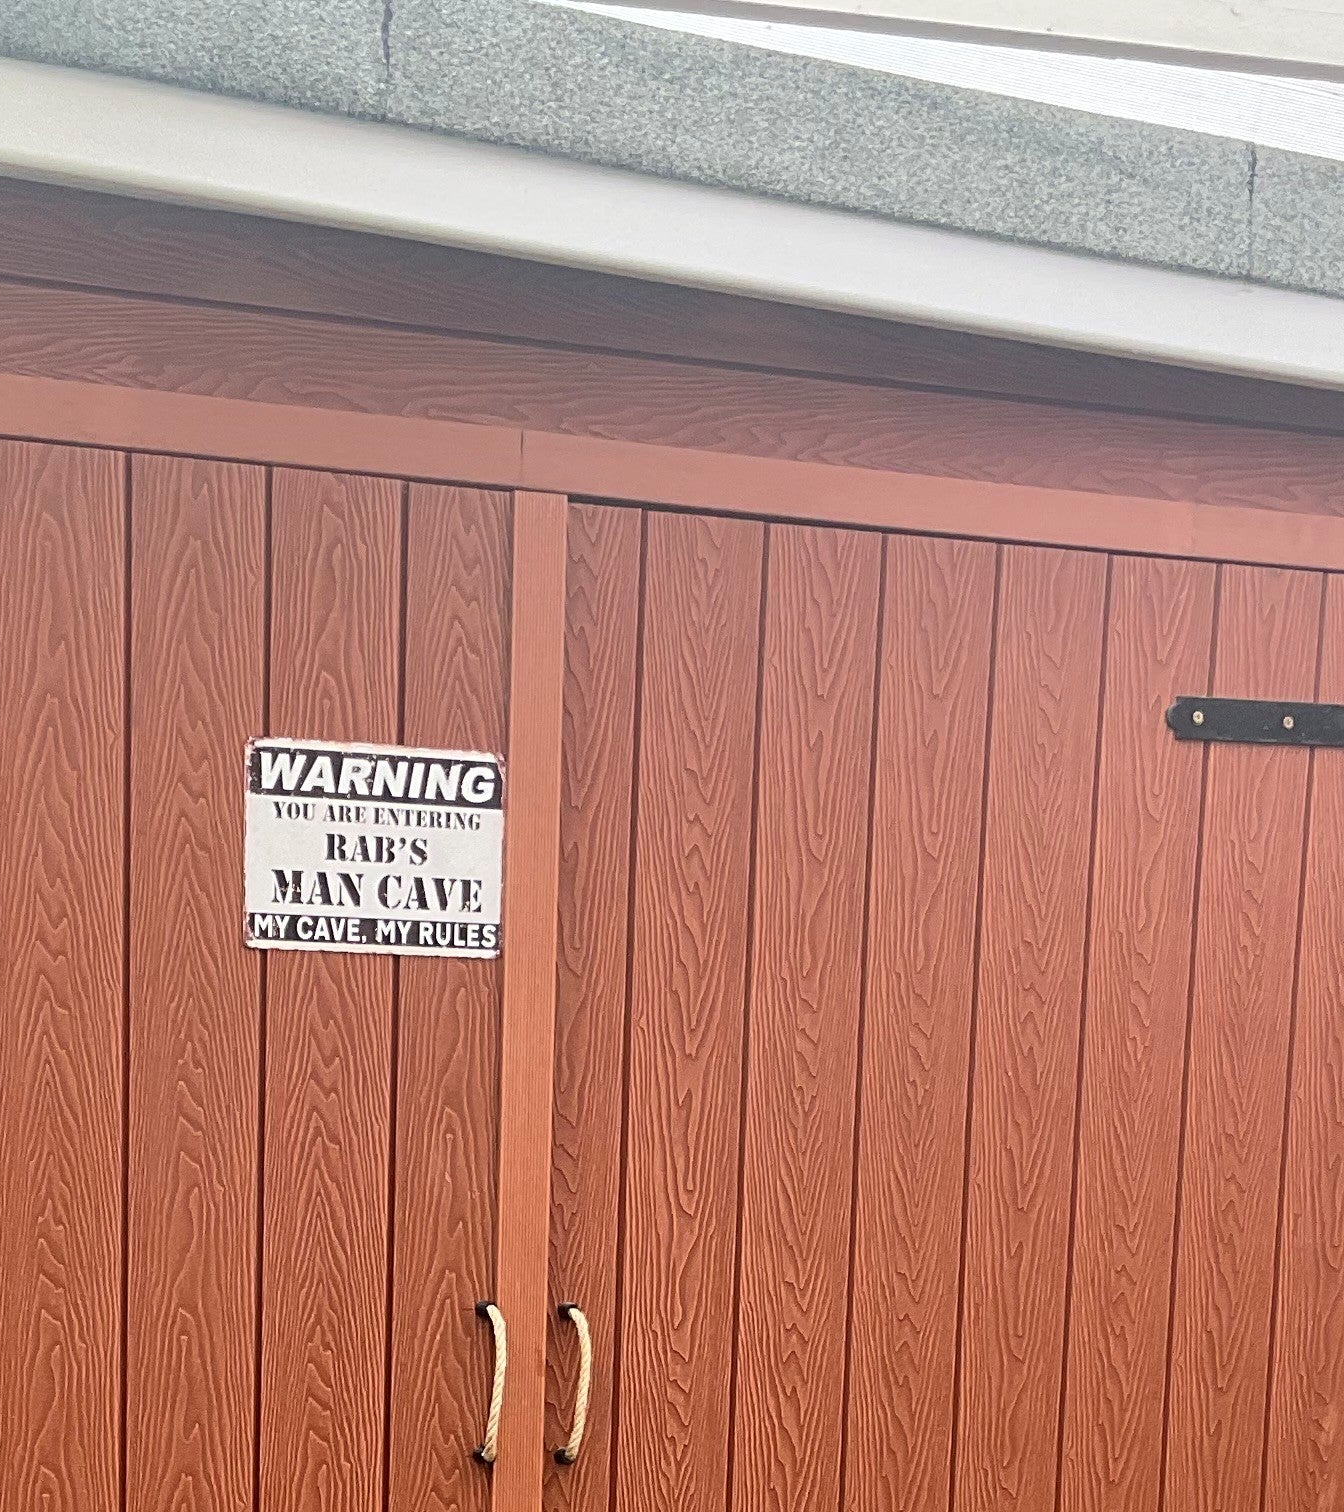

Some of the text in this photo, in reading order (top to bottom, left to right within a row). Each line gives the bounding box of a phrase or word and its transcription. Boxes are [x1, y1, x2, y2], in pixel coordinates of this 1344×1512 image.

[259, 751, 496, 804] WARNING
[272, 801, 481, 831] YOU ARE ENTERING
[271, 869, 482, 913] MAN CAVE
[254, 914, 290, 939] MY
[375, 920, 412, 943] MY
[419, 922, 497, 948] RULES
